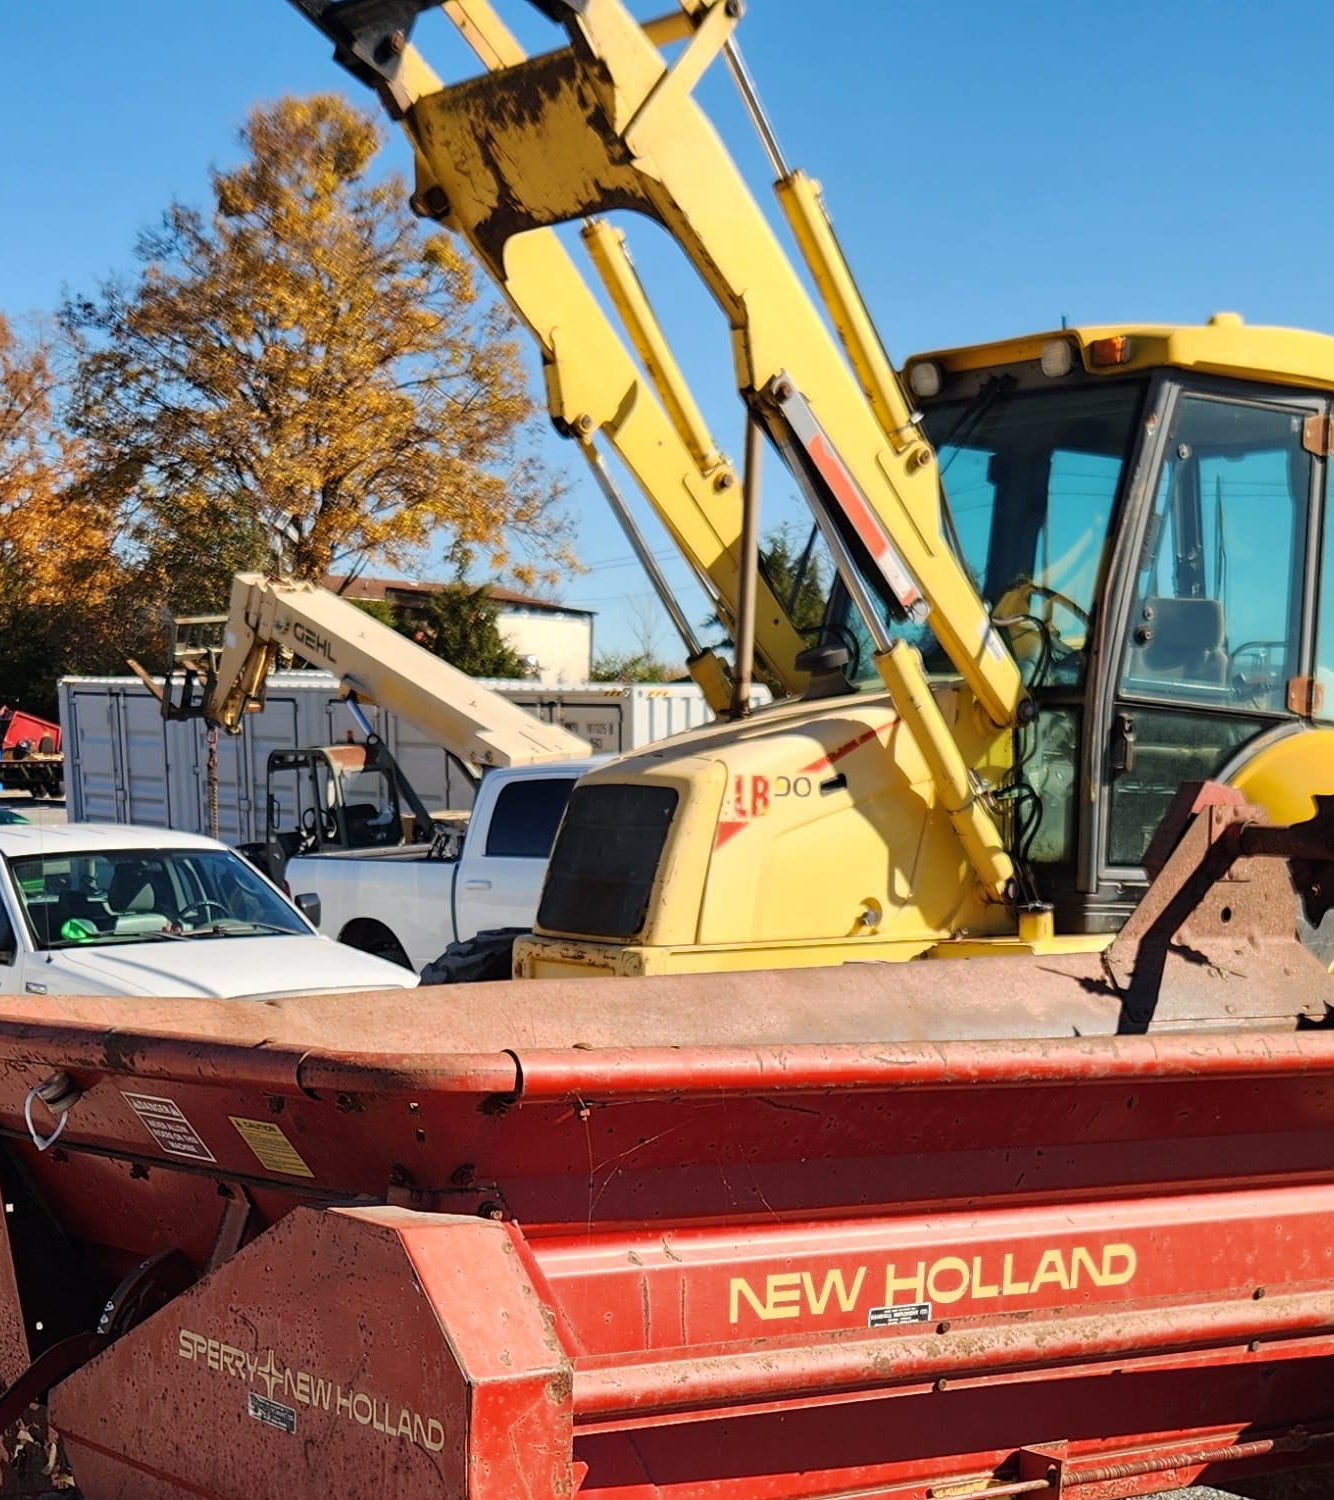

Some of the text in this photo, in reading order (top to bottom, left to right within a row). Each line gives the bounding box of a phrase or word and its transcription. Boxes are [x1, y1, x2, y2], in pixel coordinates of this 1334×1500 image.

[294, 622, 337, 664] GEHL
[137, 1100, 170, 1115] DANGER
[242, 1121, 278, 1133] CAUTION
[728, 1242, 1138, 1324] NEW HOLLAND
[178, 1329, 259, 1382] SPERRY
[284, 1367, 332, 1411] NEW
[336, 1385, 445, 1452] HOLLAND
